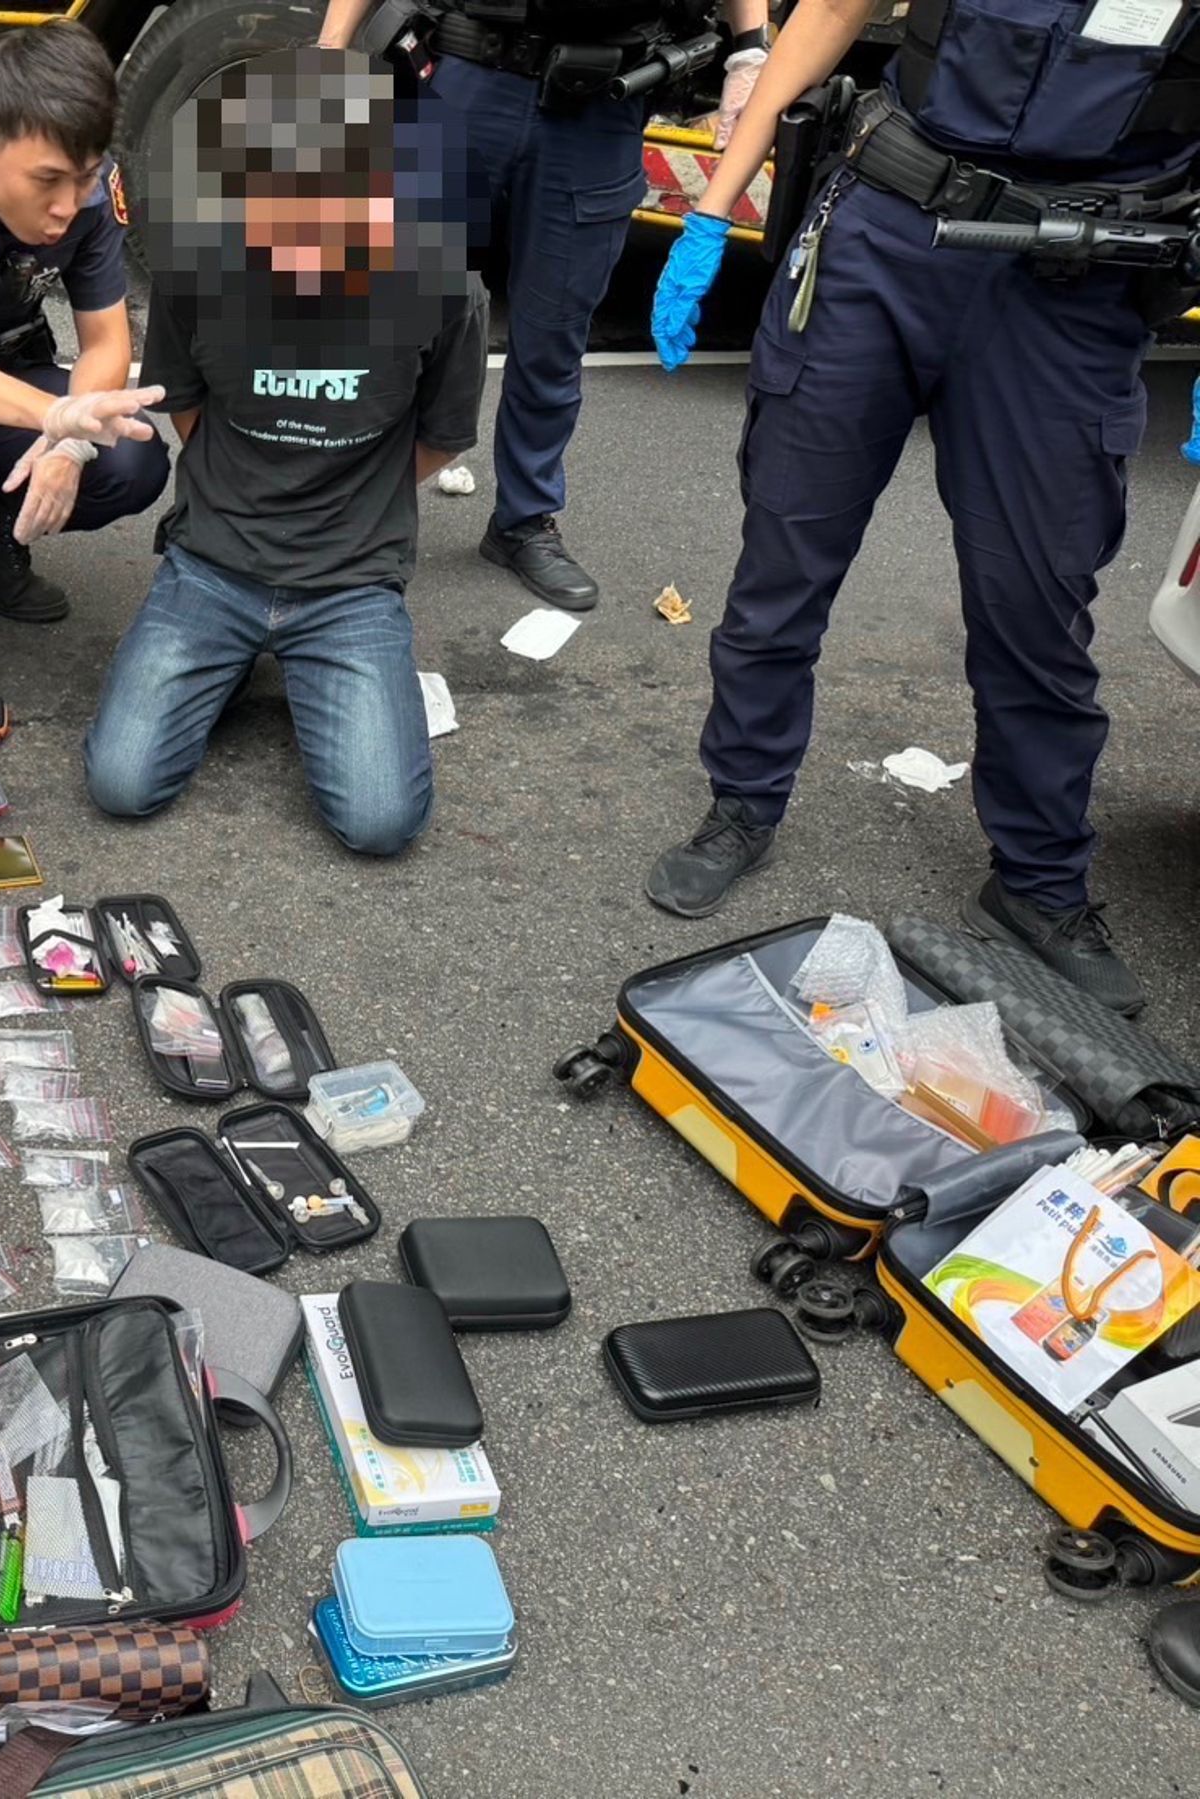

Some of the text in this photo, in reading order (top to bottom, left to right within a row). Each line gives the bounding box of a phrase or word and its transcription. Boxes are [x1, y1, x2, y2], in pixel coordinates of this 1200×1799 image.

[253, 369, 370, 401] ECLIPSE
[275, 418, 327, 434] Of the moon
[308, 436, 322, 448] the
[1036, 1199, 1063, 1222] Petit
[318, 1306, 354, 1380] EvolGuard
[1151, 1447, 1188, 1484] SAMSUNG
